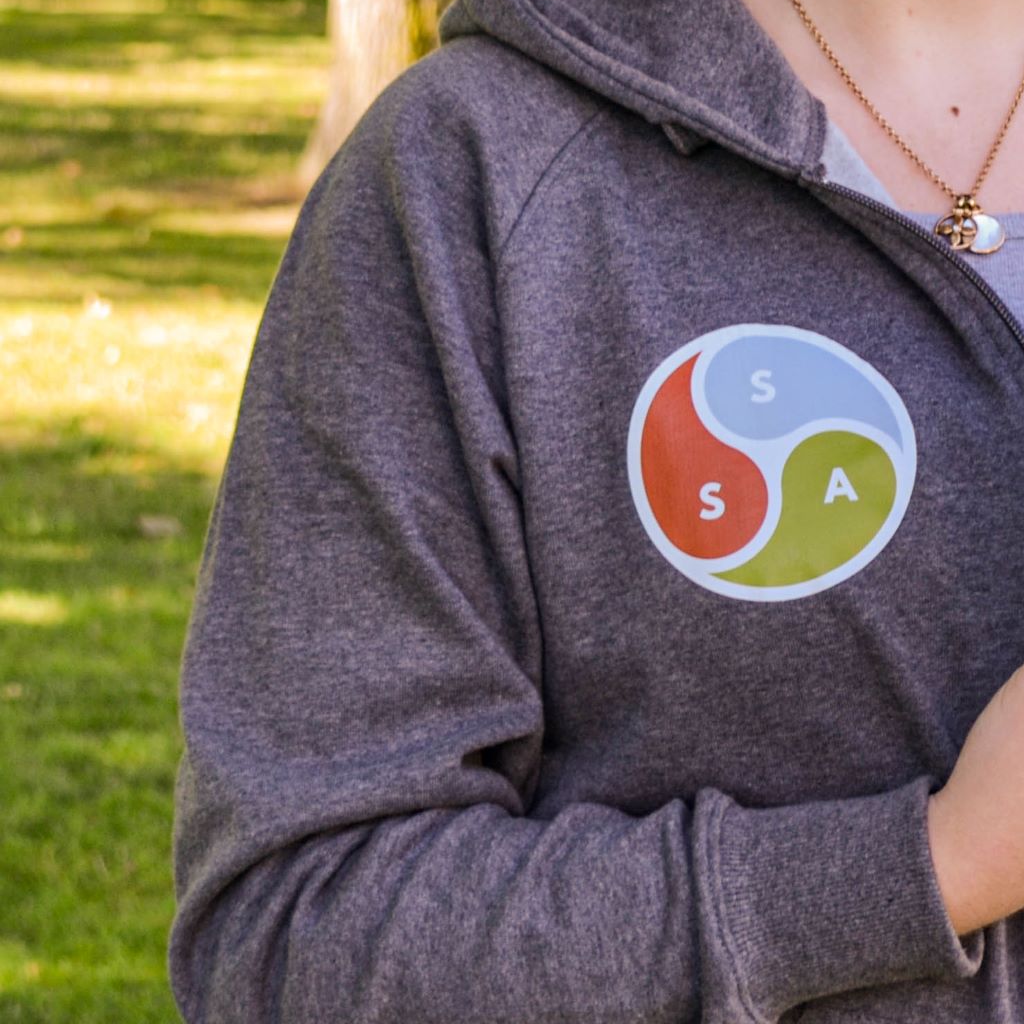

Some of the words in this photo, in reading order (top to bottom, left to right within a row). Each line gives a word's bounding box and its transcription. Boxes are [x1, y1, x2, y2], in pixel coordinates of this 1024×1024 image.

[750, 369, 776, 404] S
[699, 481, 726, 521] S
[823, 467, 859, 504] A
